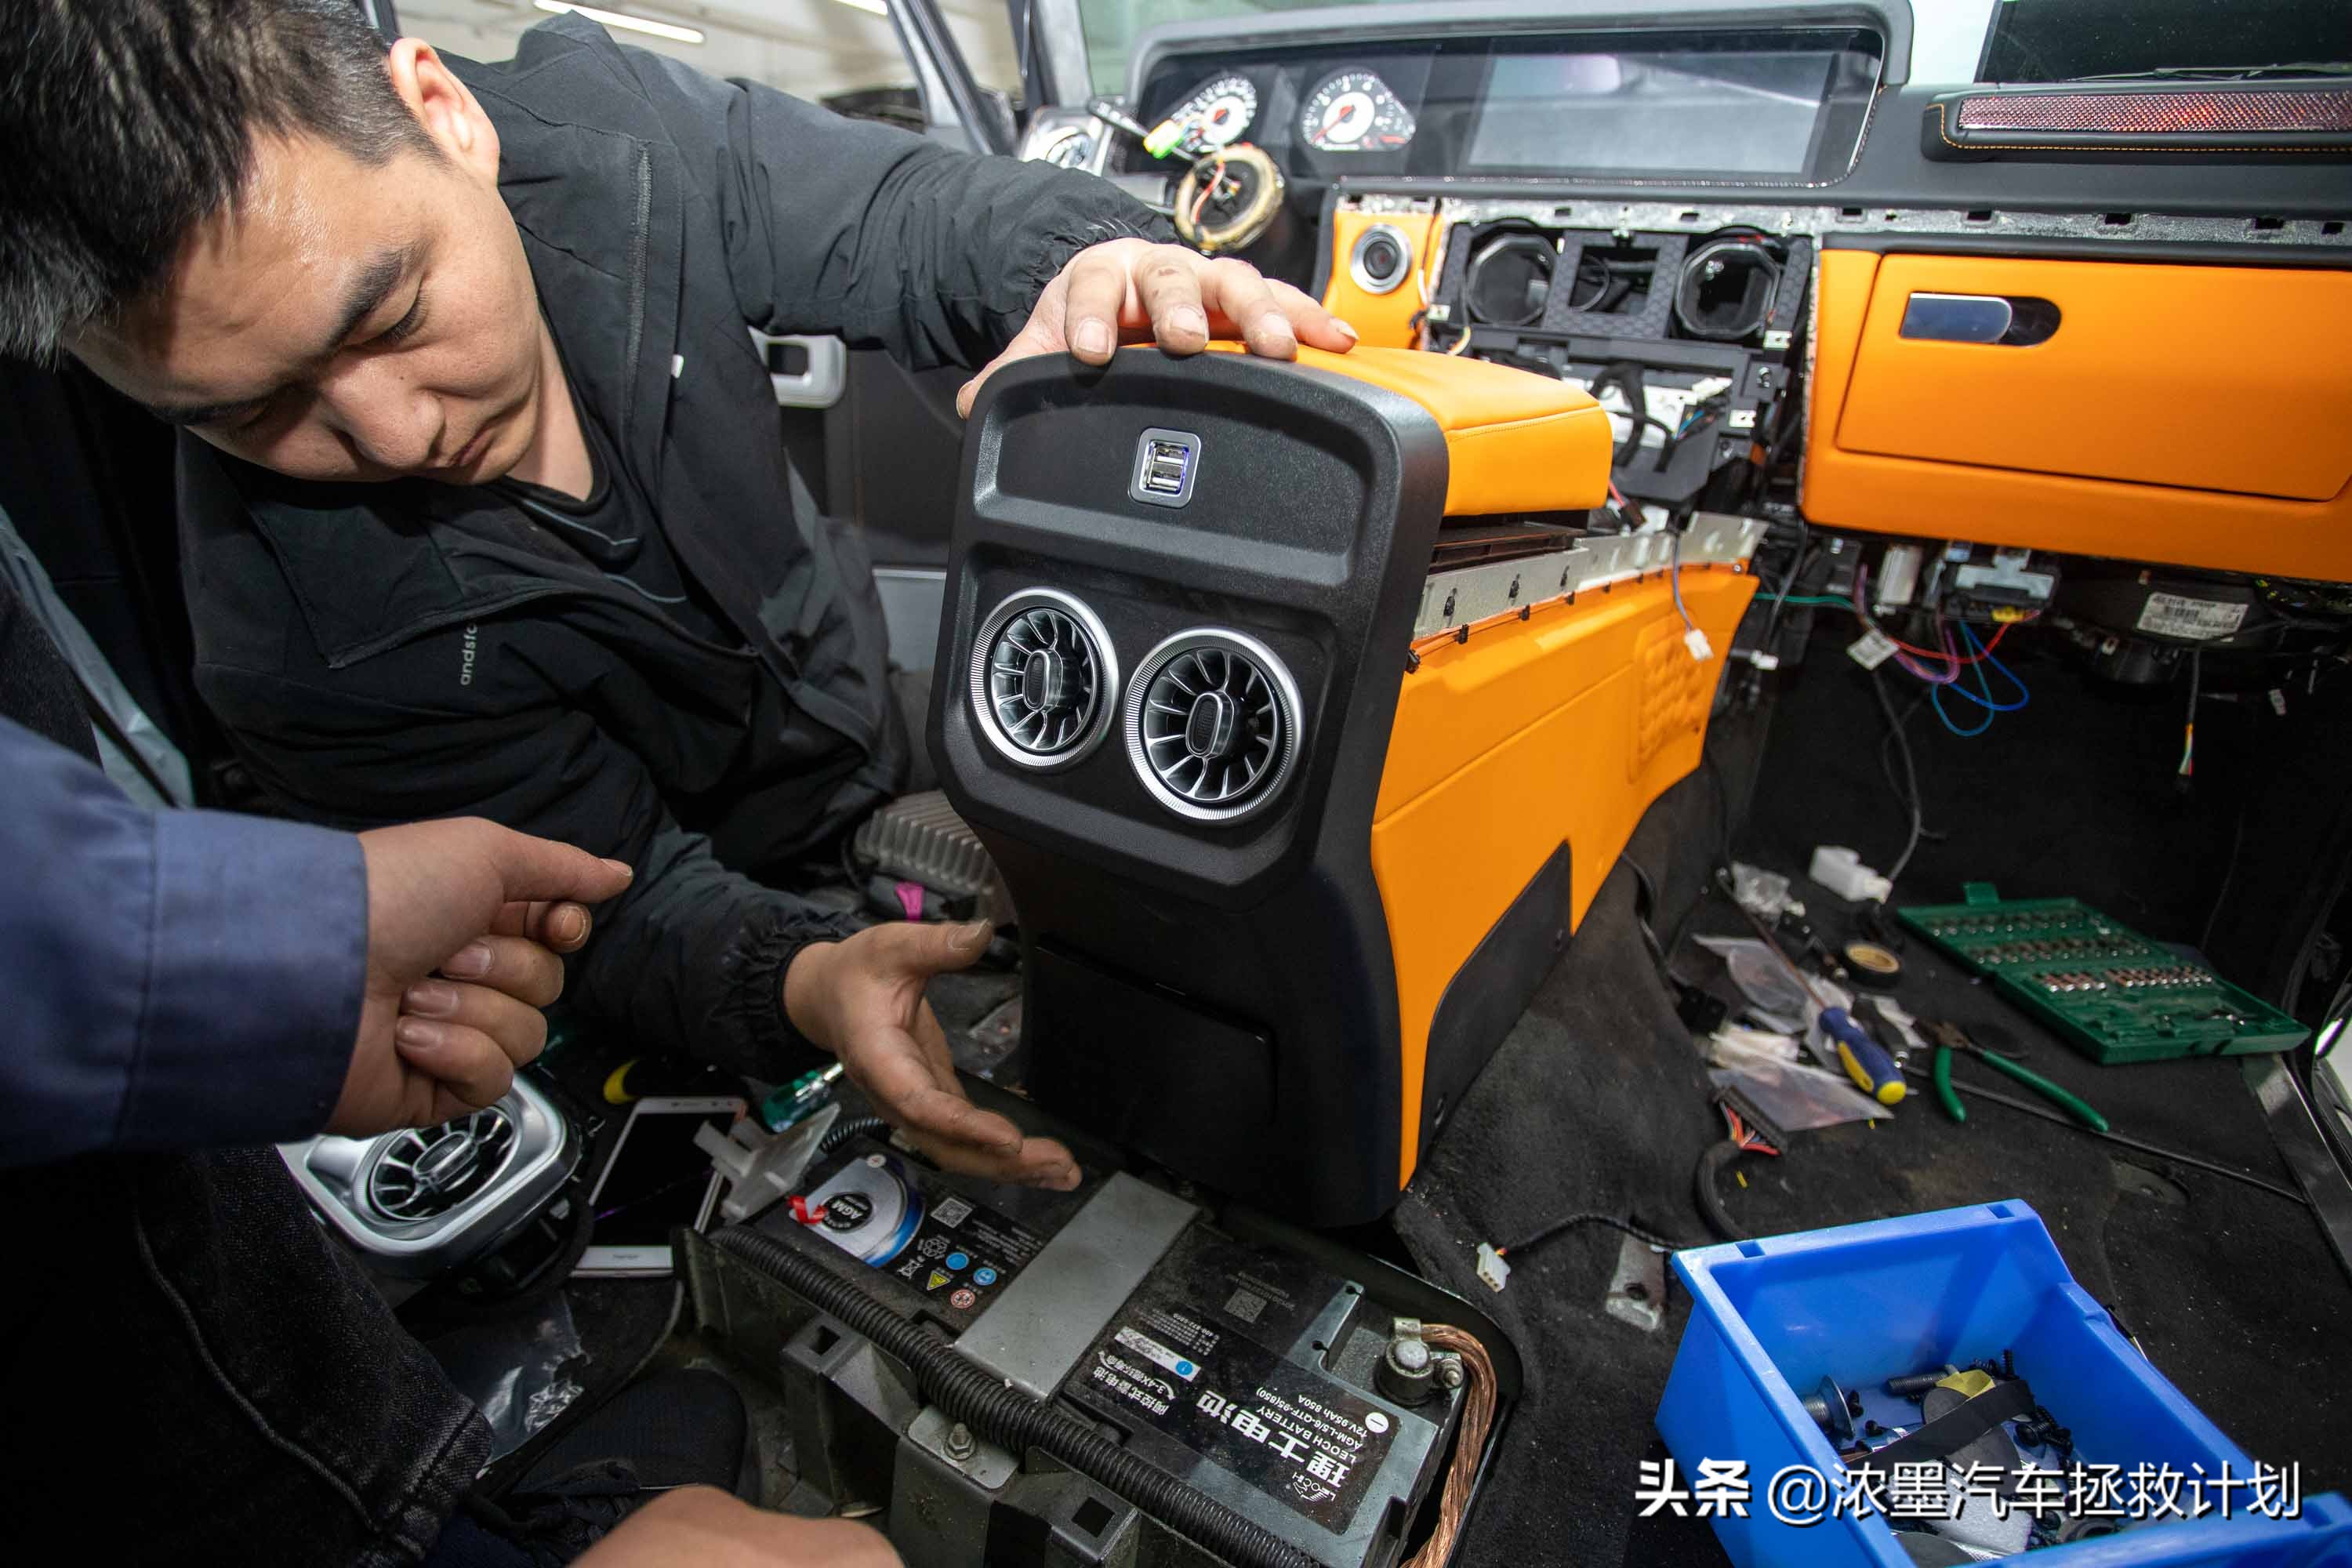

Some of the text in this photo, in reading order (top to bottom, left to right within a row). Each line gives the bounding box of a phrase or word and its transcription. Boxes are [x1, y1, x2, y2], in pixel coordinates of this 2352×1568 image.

[830, 1200, 863, 1221] AGM
[1091, 1365, 1169, 1416] 阀控式蓄电池
[1296, 1393, 1322, 1412] 850A
[1254, 1386, 1363, 1449] AGM-L5/6-QTF-95(850)
[1255, 1404, 1357, 1464] LEOCH BATTERY
[1321, 1406, 1349, 1427] 95Ah
[1194, 1388, 1350, 1488] 理士电池
[1291, 1469, 1338, 1501] LEOCH
